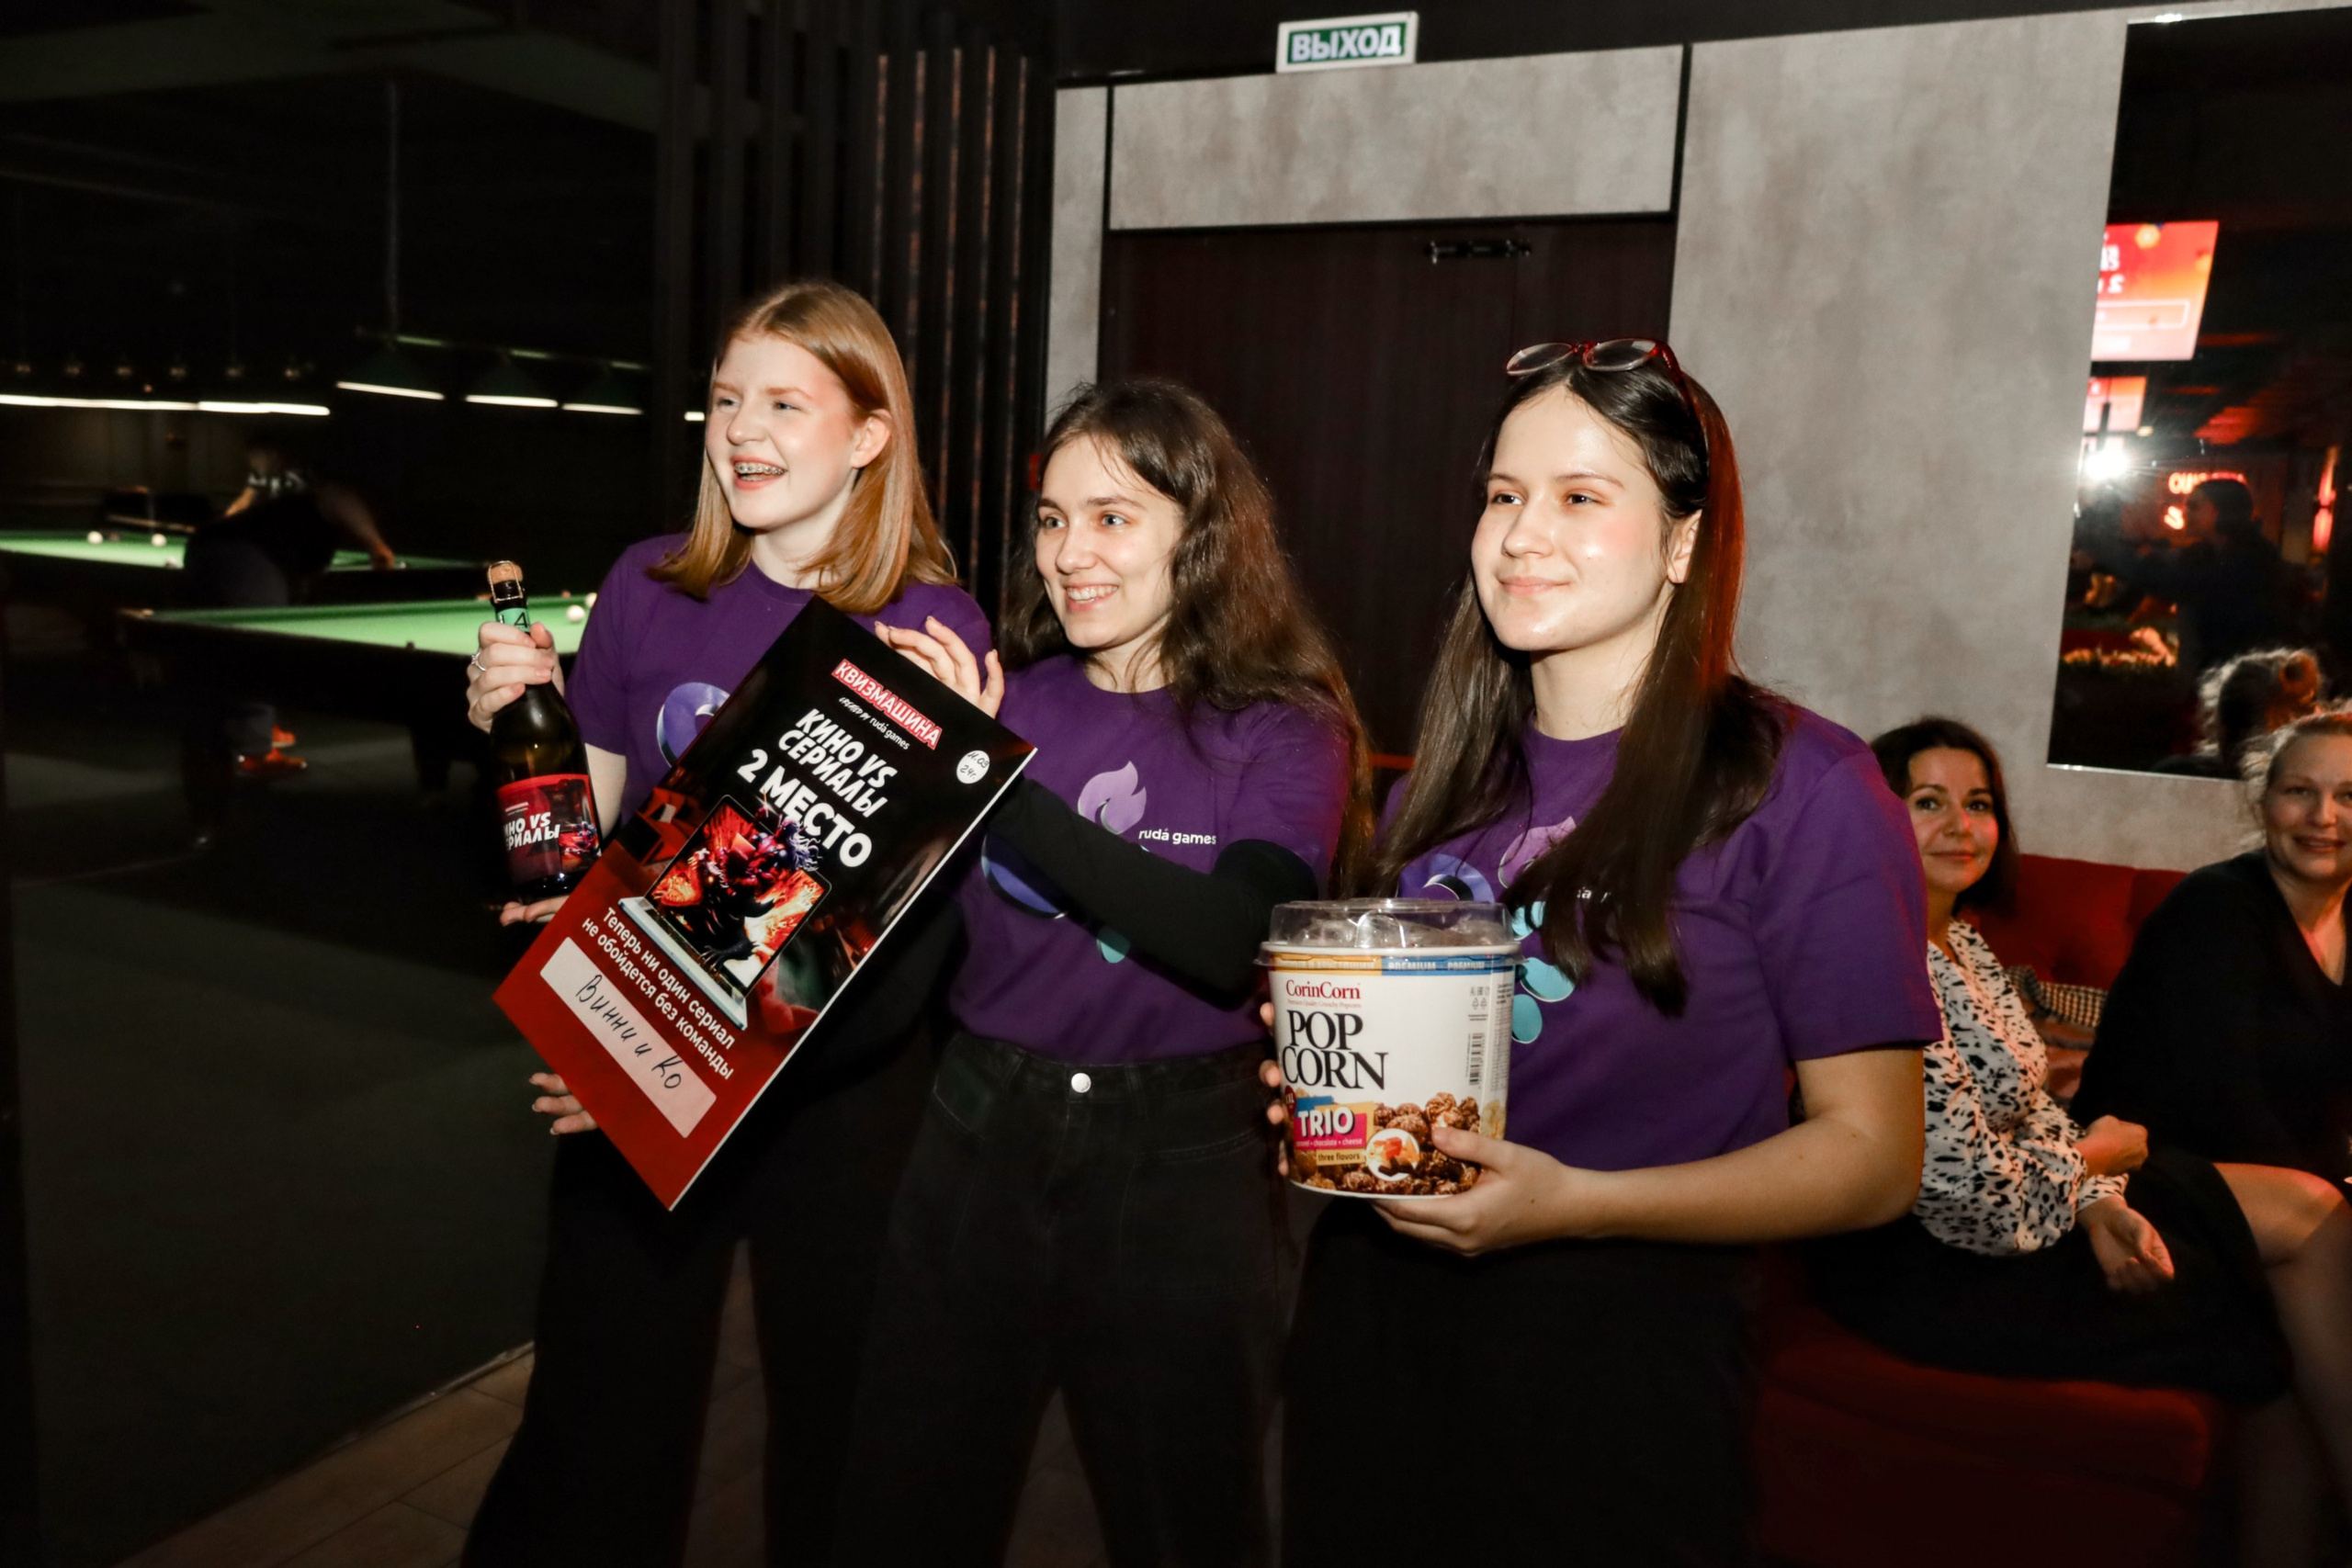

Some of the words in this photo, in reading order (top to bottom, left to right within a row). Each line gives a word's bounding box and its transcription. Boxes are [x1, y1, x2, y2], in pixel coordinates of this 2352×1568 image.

[1292, 25, 1401, 62] ВЫХОД
[835, 660, 941, 747] КВИЗМАШИНА
[796, 708, 865, 763] КИНО
[857, 753, 898, 788] VS
[884, 729, 910, 750] games
[778, 729, 888, 818] СЕРИАЛЫ
[529, 812, 551, 829] VS
[737, 749, 768, 784] 2
[759, 765, 872, 867] МЕСТО
[505, 824, 560, 851] РИАЛЫ
[1138, 828, 1170, 841] rudá
[1172, 831, 1216, 845] games
[603, 907, 641, 954] Теперь
[640, 951, 661, 972] ни
[658, 968, 691, 1004] один
[689, 1000, 735, 1049] сериал
[1286, 979, 1362, 999] CorinCorn
[582, 918, 599, 937] не
[597, 934, 657, 998] обойдется
[655, 993, 679, 1021] без
[675, 1017, 734, 1080] команды
[575, 975, 638, 1043] Винни
[634, 1043, 652, 1057] и
[651, 1055, 684, 1089] Ко
[1286, 1010, 1363, 1051] POP
[1283, 1046, 1389, 1090] CORN
[1298, 1107, 1354, 1136] TRIO
[1336, 1152, 1360, 1160] flavors
